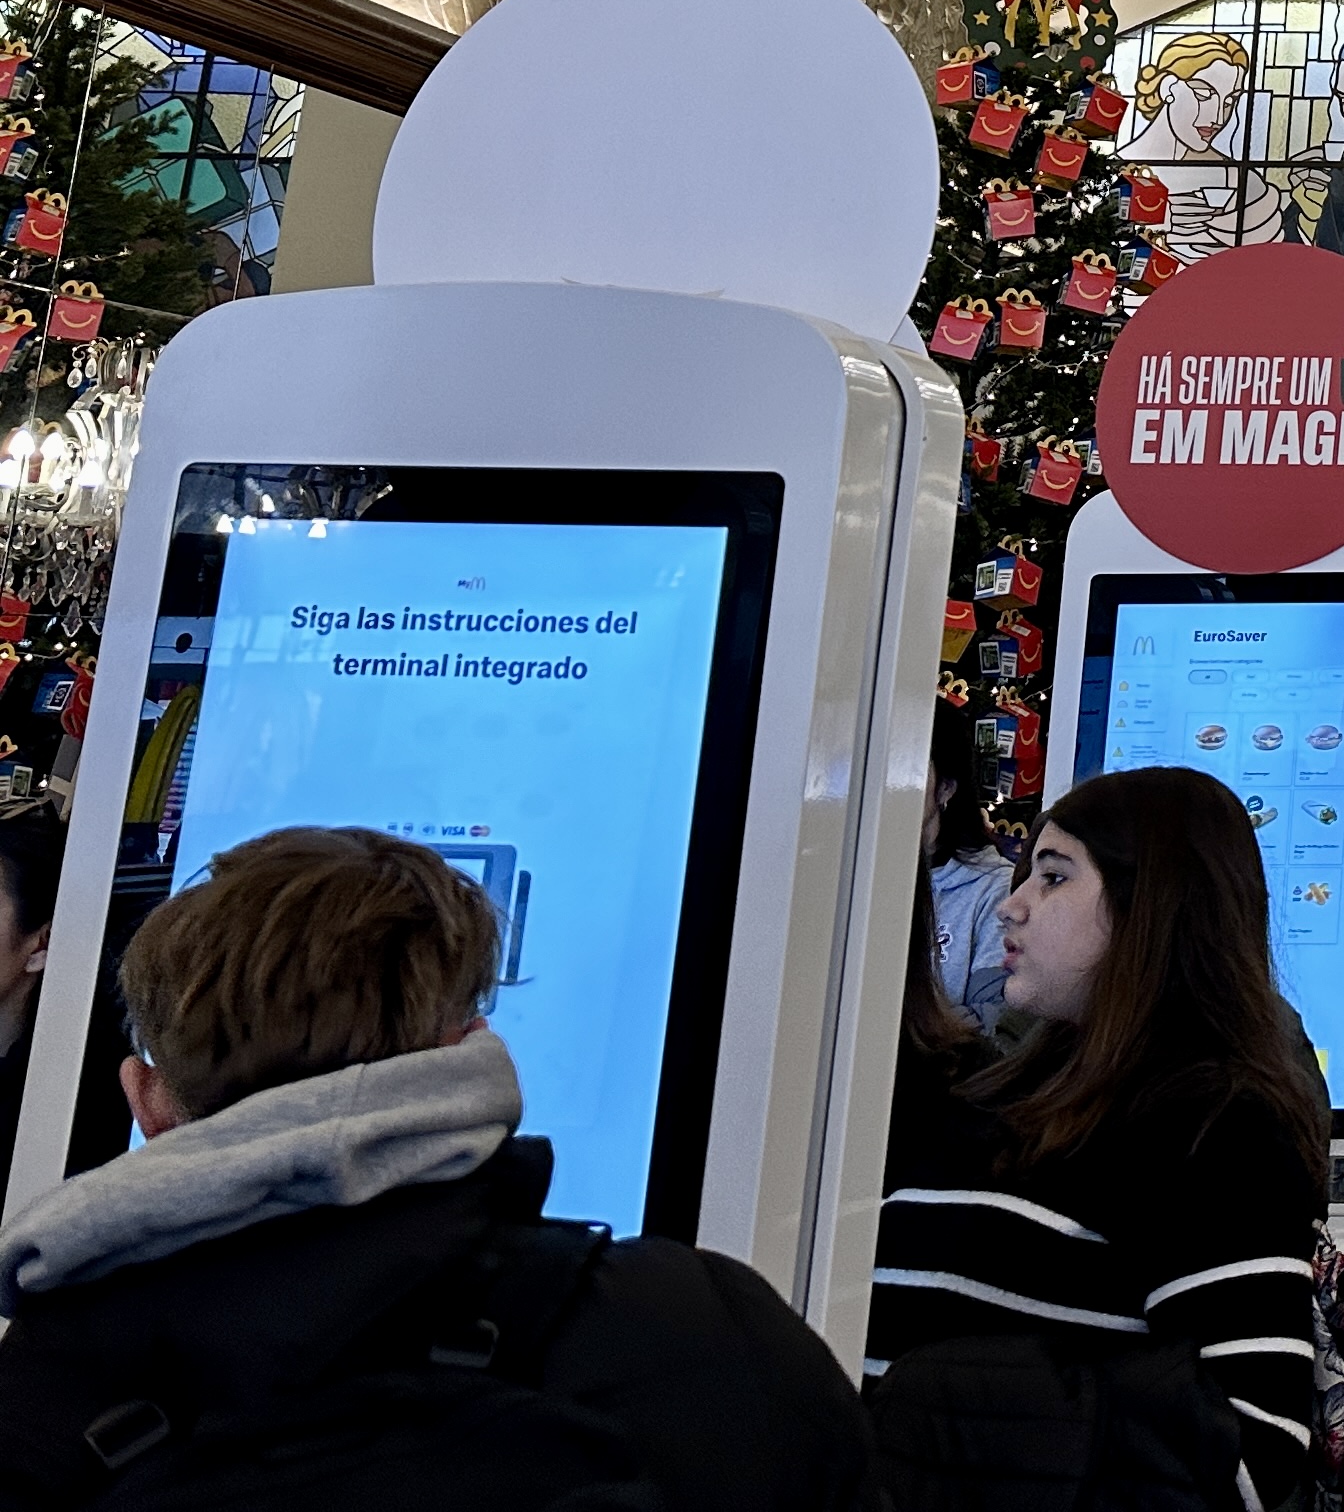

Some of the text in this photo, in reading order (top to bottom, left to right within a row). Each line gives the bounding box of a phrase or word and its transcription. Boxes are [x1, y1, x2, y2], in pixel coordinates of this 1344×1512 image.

[1137, 351, 1172, 404] HÁ
[1179, 355, 1285, 406] SEMPRE
[1290, 357, 1332, 406] UM
[1130, 409, 1209, 464] EM
[291, 605, 638, 636] Siga las instrucciones del
[1194, 630, 1268, 642] EuroSaver
[333, 653, 588, 685] terminal integrado
[441, 826, 465, 836] VISA
